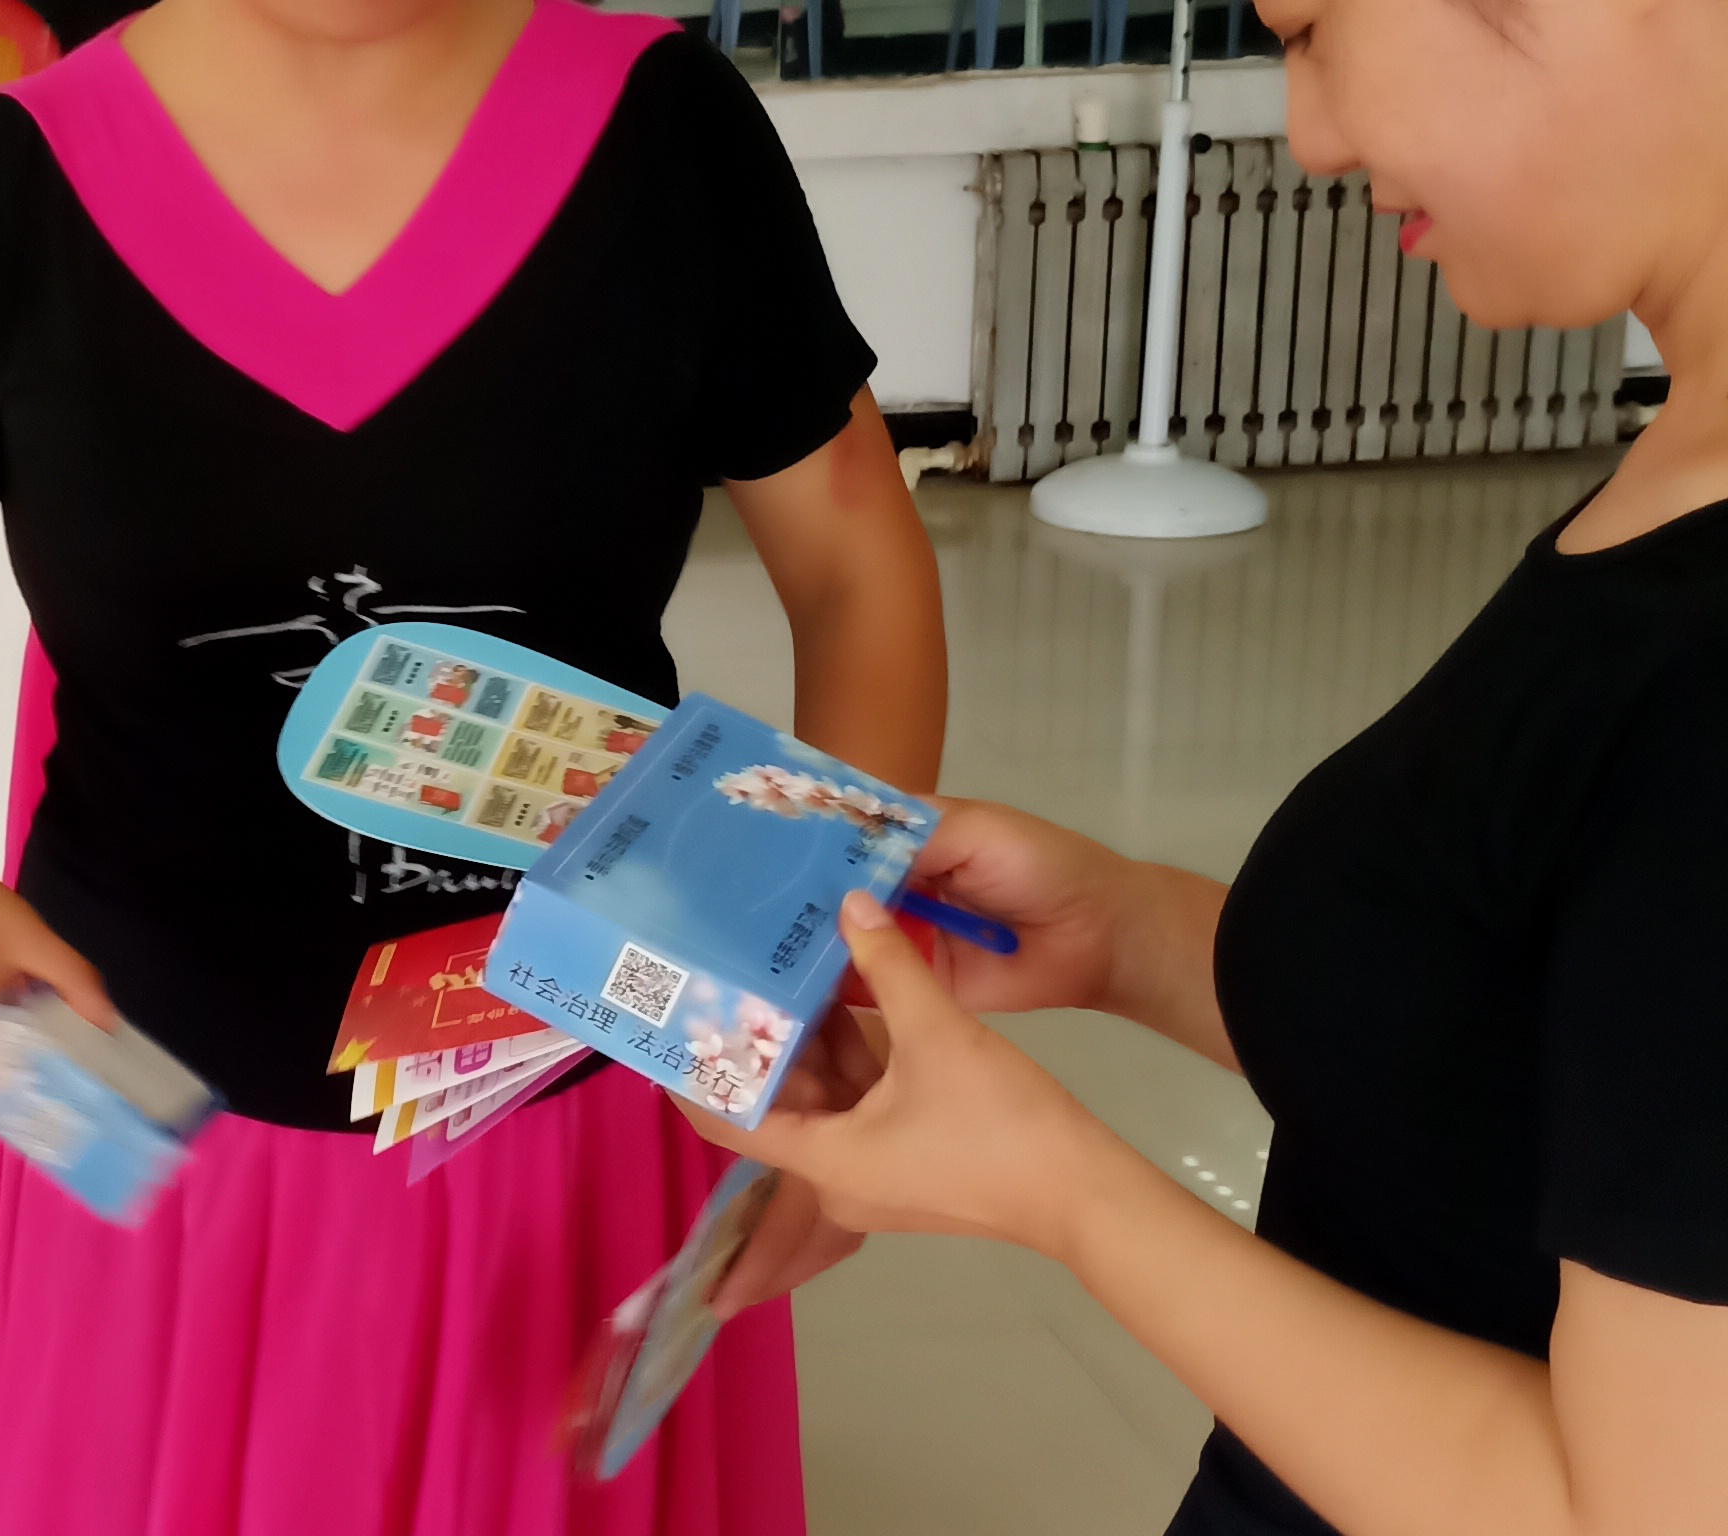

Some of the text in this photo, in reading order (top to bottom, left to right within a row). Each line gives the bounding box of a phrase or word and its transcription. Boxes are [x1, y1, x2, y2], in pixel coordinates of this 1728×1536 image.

[509, 960, 743, 1101] 社会治理 法治先行
